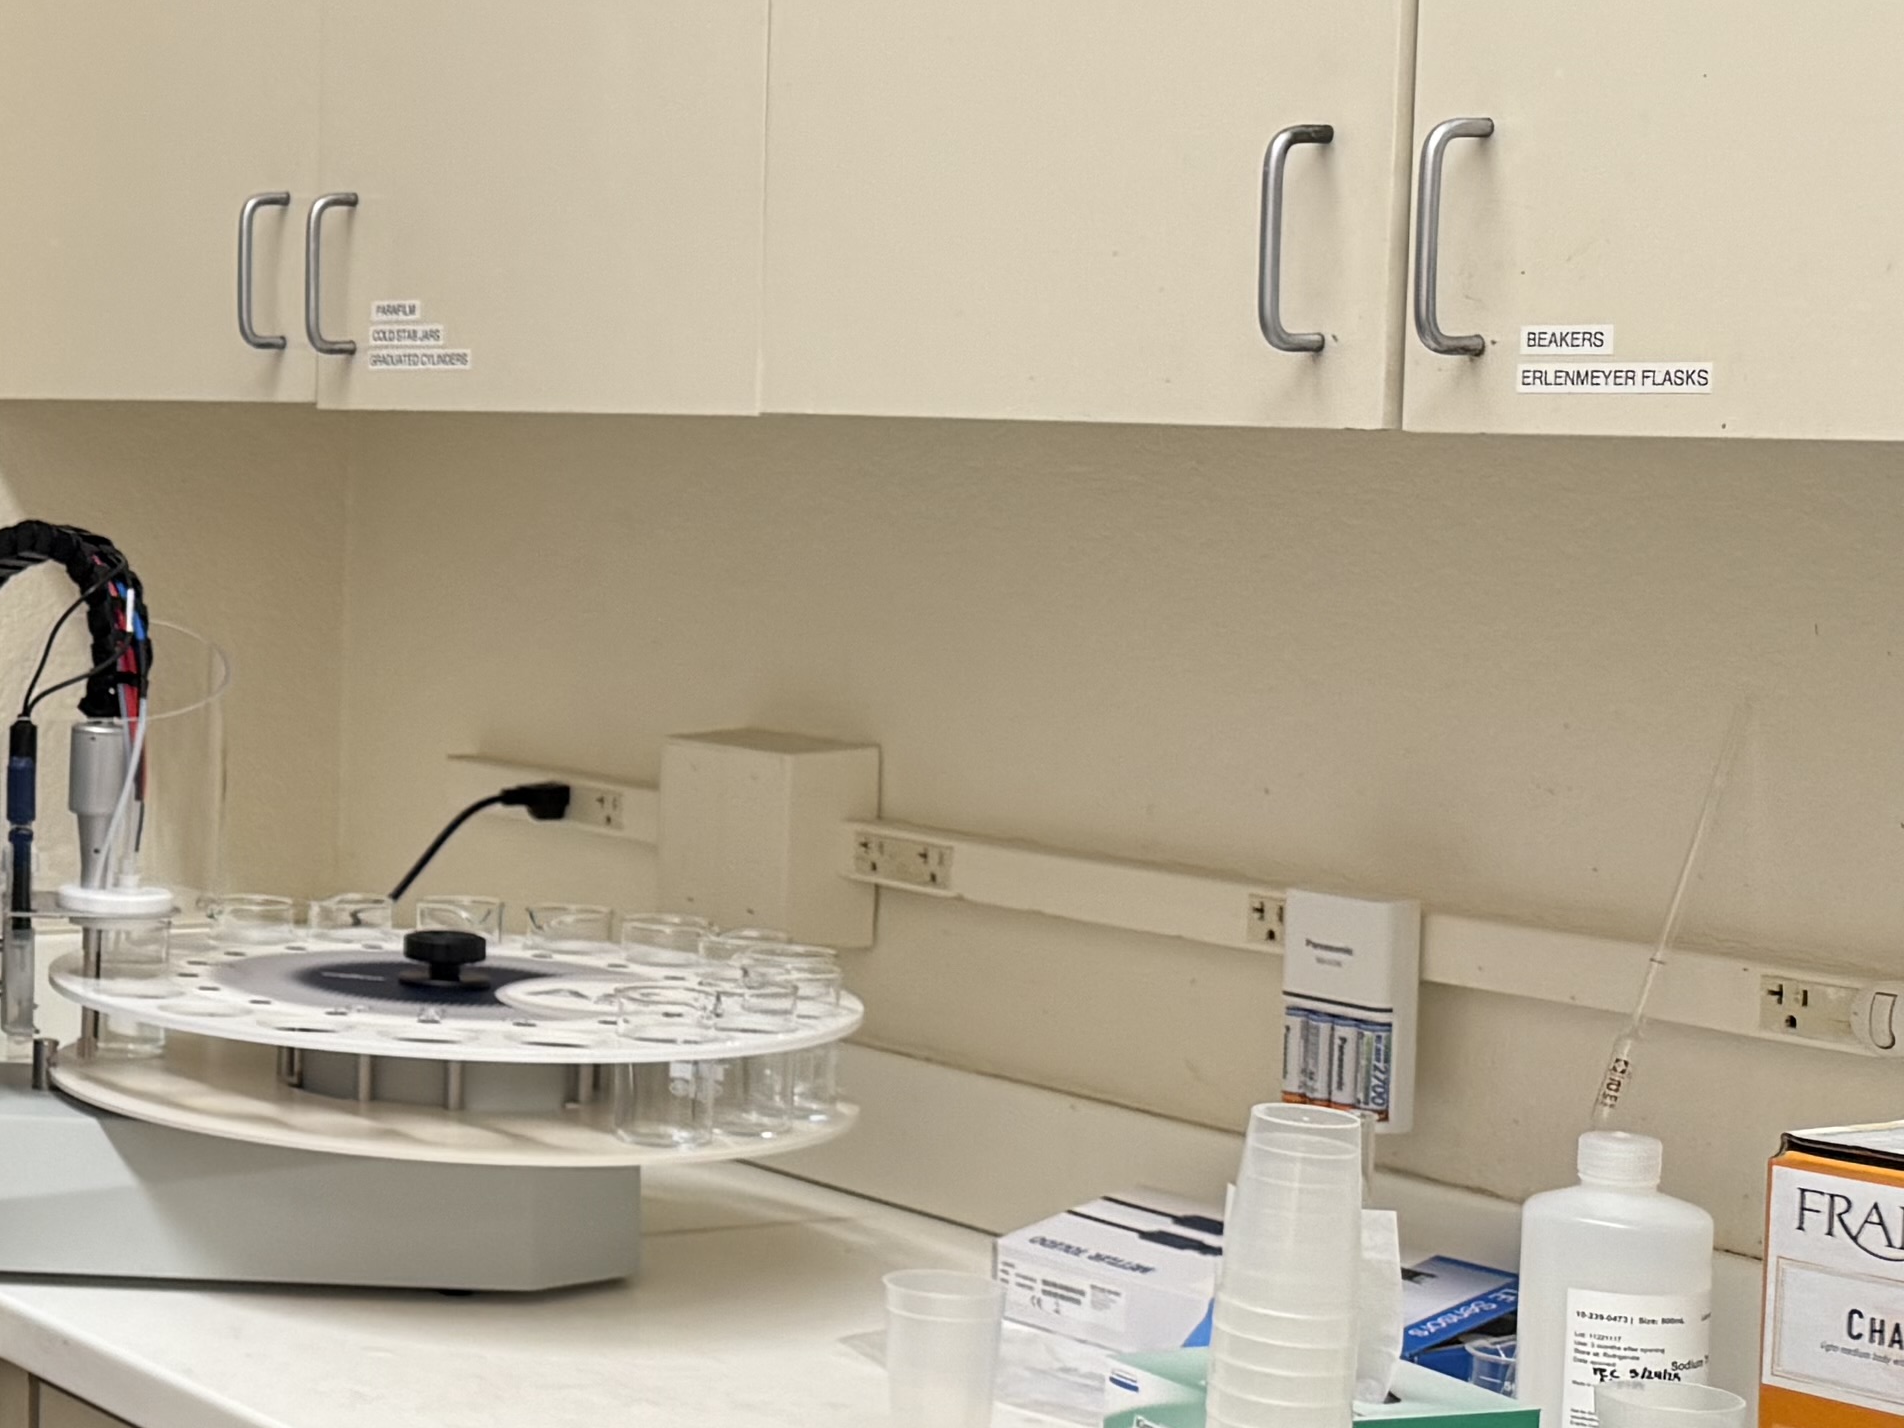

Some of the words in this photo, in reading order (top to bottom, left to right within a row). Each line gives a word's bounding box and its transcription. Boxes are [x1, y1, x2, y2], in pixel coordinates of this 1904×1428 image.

[376, 304, 416, 316] PARAFILM
[1527, 331, 1605, 348] BEAKERS
[370, 354, 419, 366] GRADUATED
[420, 353, 469, 366] CYLINDERS
[1521, 369, 1636, 386] ERLENMEYER
[1641, 369, 1709, 386] FLASKS
[1371, 1066, 1387, 1108] 2700
[1029, 1236, 1088, 1258] TOLEDO
[1408, 1300, 1497, 1337] Sensors
[1638, 1317, 1658, 1325] Size:
[1671, 1358, 1703, 1372] Sodium
